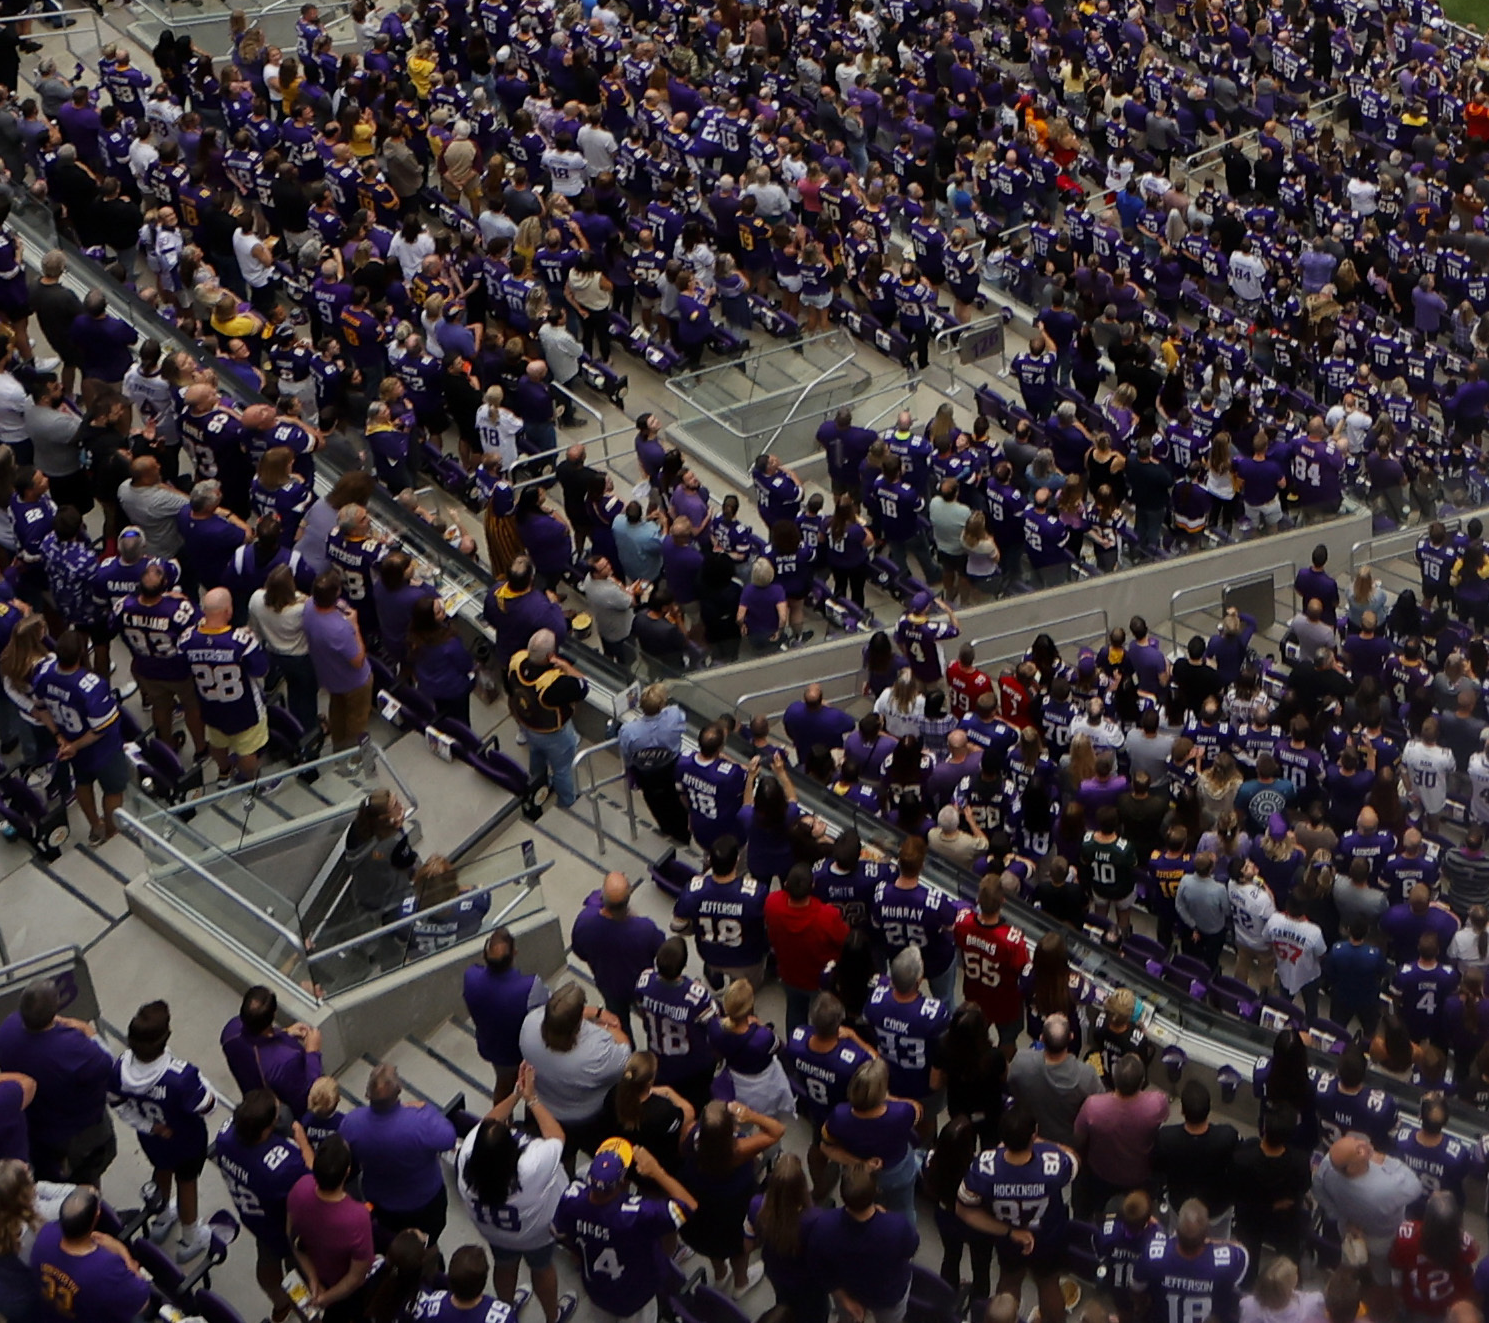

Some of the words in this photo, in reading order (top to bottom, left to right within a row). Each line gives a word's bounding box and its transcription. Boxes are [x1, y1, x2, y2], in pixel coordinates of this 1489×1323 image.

[207, 411, 229, 434] 93
[25, 508, 44, 523] 22
[1422, 559, 1441, 582] 18
[134, 614, 172, 631] WILLIAMS
[173, 600, 196, 626] 93
[124, 628, 177, 659] 93
[186, 647, 236, 664] PETERSON
[910, 641, 926, 664] 4
[78, 671, 102, 694] 99
[191, 663, 244, 704] 28
[1042, 722, 1068, 744] 70
[681, 772, 718, 796] JEFFERSON
[1279, 763, 1308, 788] 10
[688, 788, 718, 821] 18
[1094, 851, 1112, 863] LOVE
[1090, 861, 1118, 886] 10
[827, 885, 855, 899] SMITH
[924, 887, 943, 911] 25
[698, 899, 744, 918] JEFFERSON
[880, 906, 924, 923] MURRAY
[698, 916, 744, 950] 18
[882, 919, 929, 951] 25
[964, 932, 998, 957] BROOKS
[1271, 926, 1308, 944] SANTANA
[1272, 940, 1304, 964] 57
[962, 953, 1003, 989] 55
[642, 995, 690, 1021] JEFFERSON
[919, 998, 942, 1021] 33
[1416, 990, 1437, 1016] 4
[642, 1014, 691, 1056] 18
[882, 1017, 910, 1036] COOK
[839, 1047, 856, 1065] 8
[876, 1030, 928, 1071] 33
[795, 1058, 836, 1085] COUSINS
[805, 1077, 829, 1107] 8
[220, 1153, 251, 1185] SMITH
[261, 1144, 291, 1172] 22
[993, 1182, 1046, 1198] HOCKENSON
[992, 1196, 1052, 1228] 87
[576, 1218, 611, 1243] DIGGS
[1160, 1274, 1215, 1293] JEFFERSON
[1164, 1292, 1214, 1323] 18
